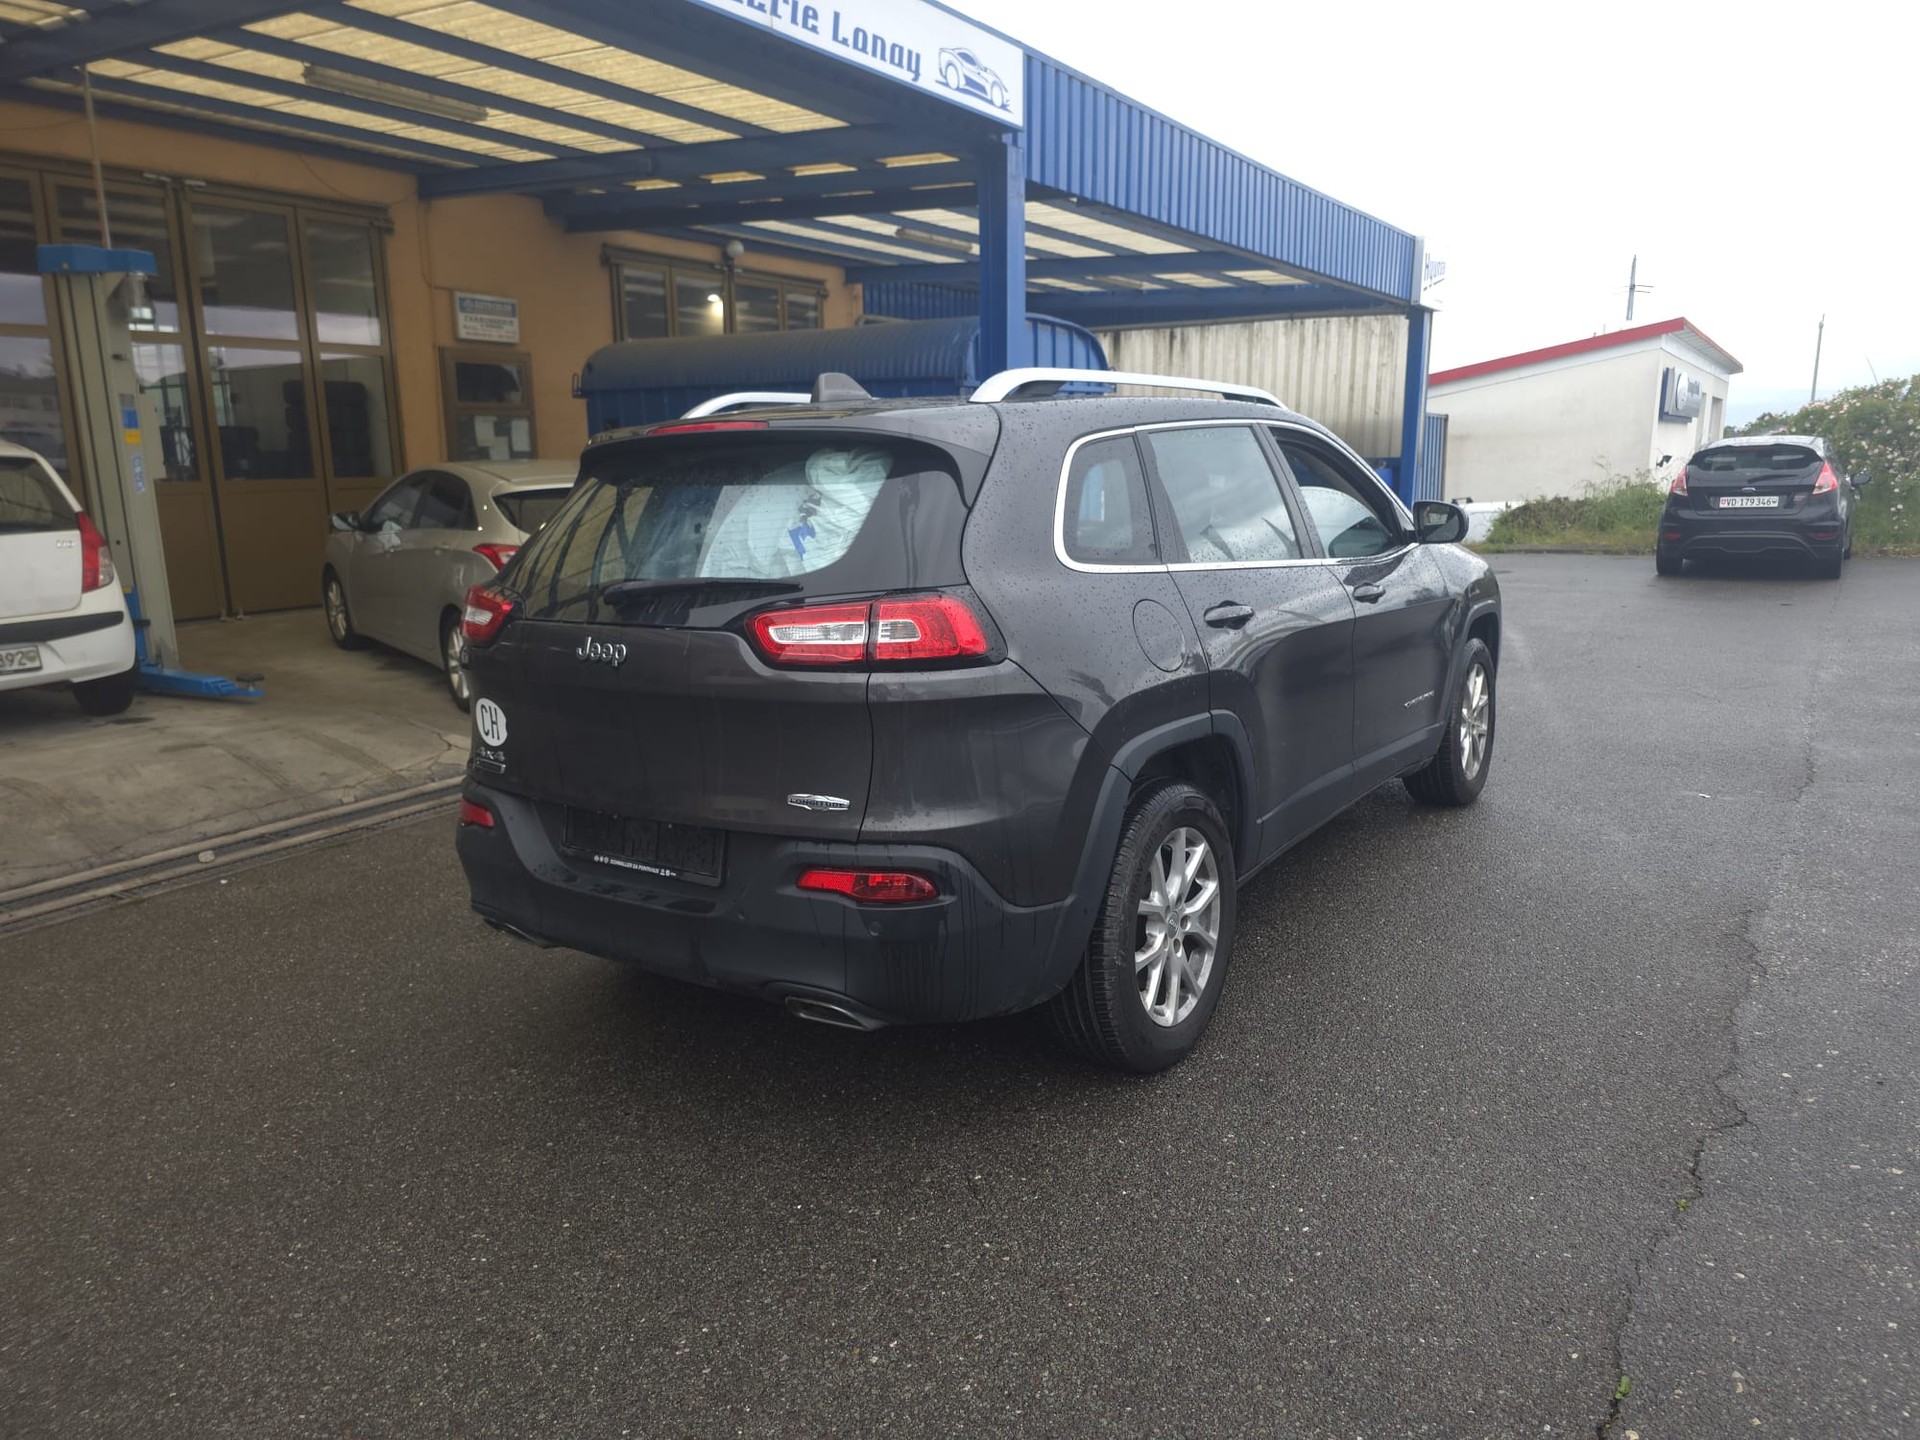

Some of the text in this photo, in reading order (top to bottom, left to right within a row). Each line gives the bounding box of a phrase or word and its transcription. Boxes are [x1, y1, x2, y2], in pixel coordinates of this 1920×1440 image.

[831, 10, 921, 82] Lonay
[1726, 499, 1737, 507] VD
[576, 637, 627, 667] Jeep
[480, 703, 500, 741] CH
